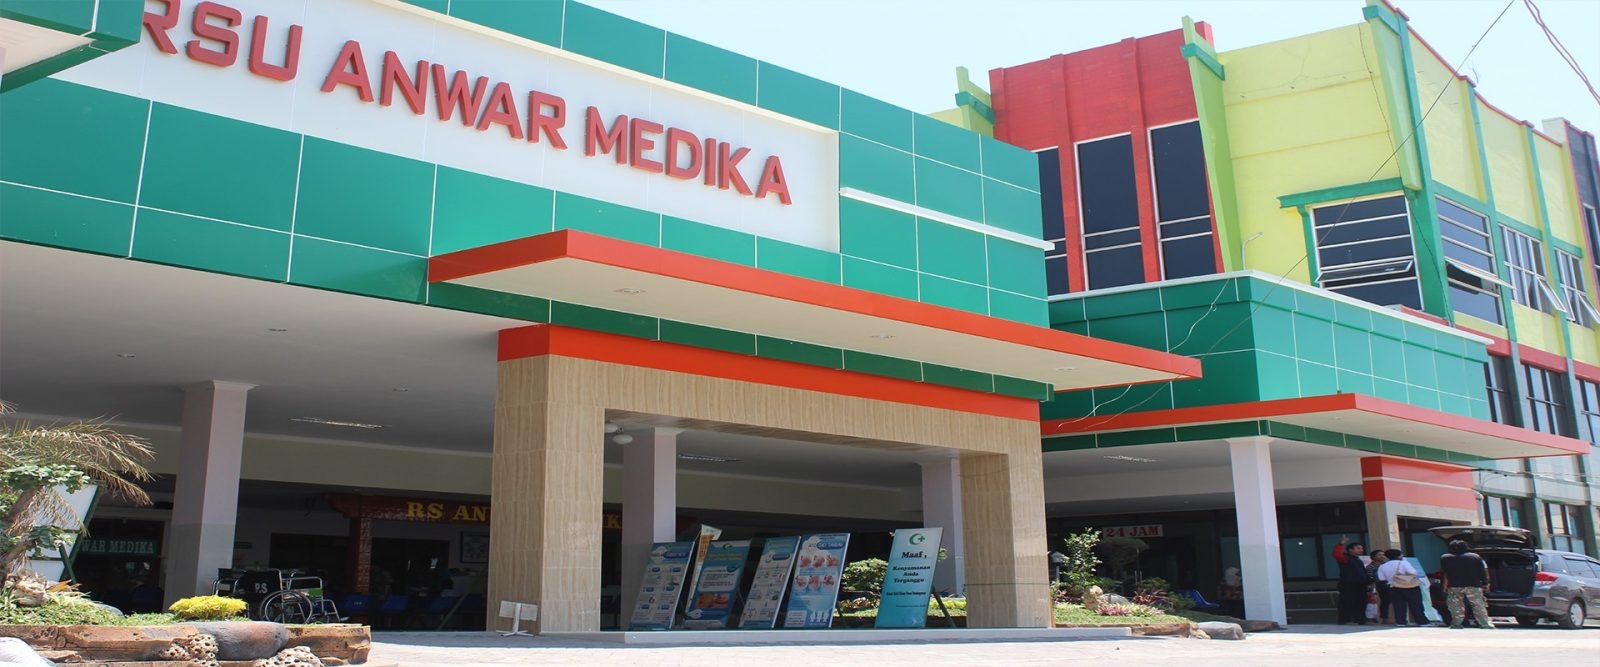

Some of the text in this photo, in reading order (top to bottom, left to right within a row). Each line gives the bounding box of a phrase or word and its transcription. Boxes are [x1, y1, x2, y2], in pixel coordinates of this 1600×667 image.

[143, 0, 792, 205] RSU ANWAR MEDIKA
[405, 501, 491, 522] RS AN
[1106, 526, 1159, 537] 24 JAM
[81, 540, 154, 554] WAR MEDIKA
